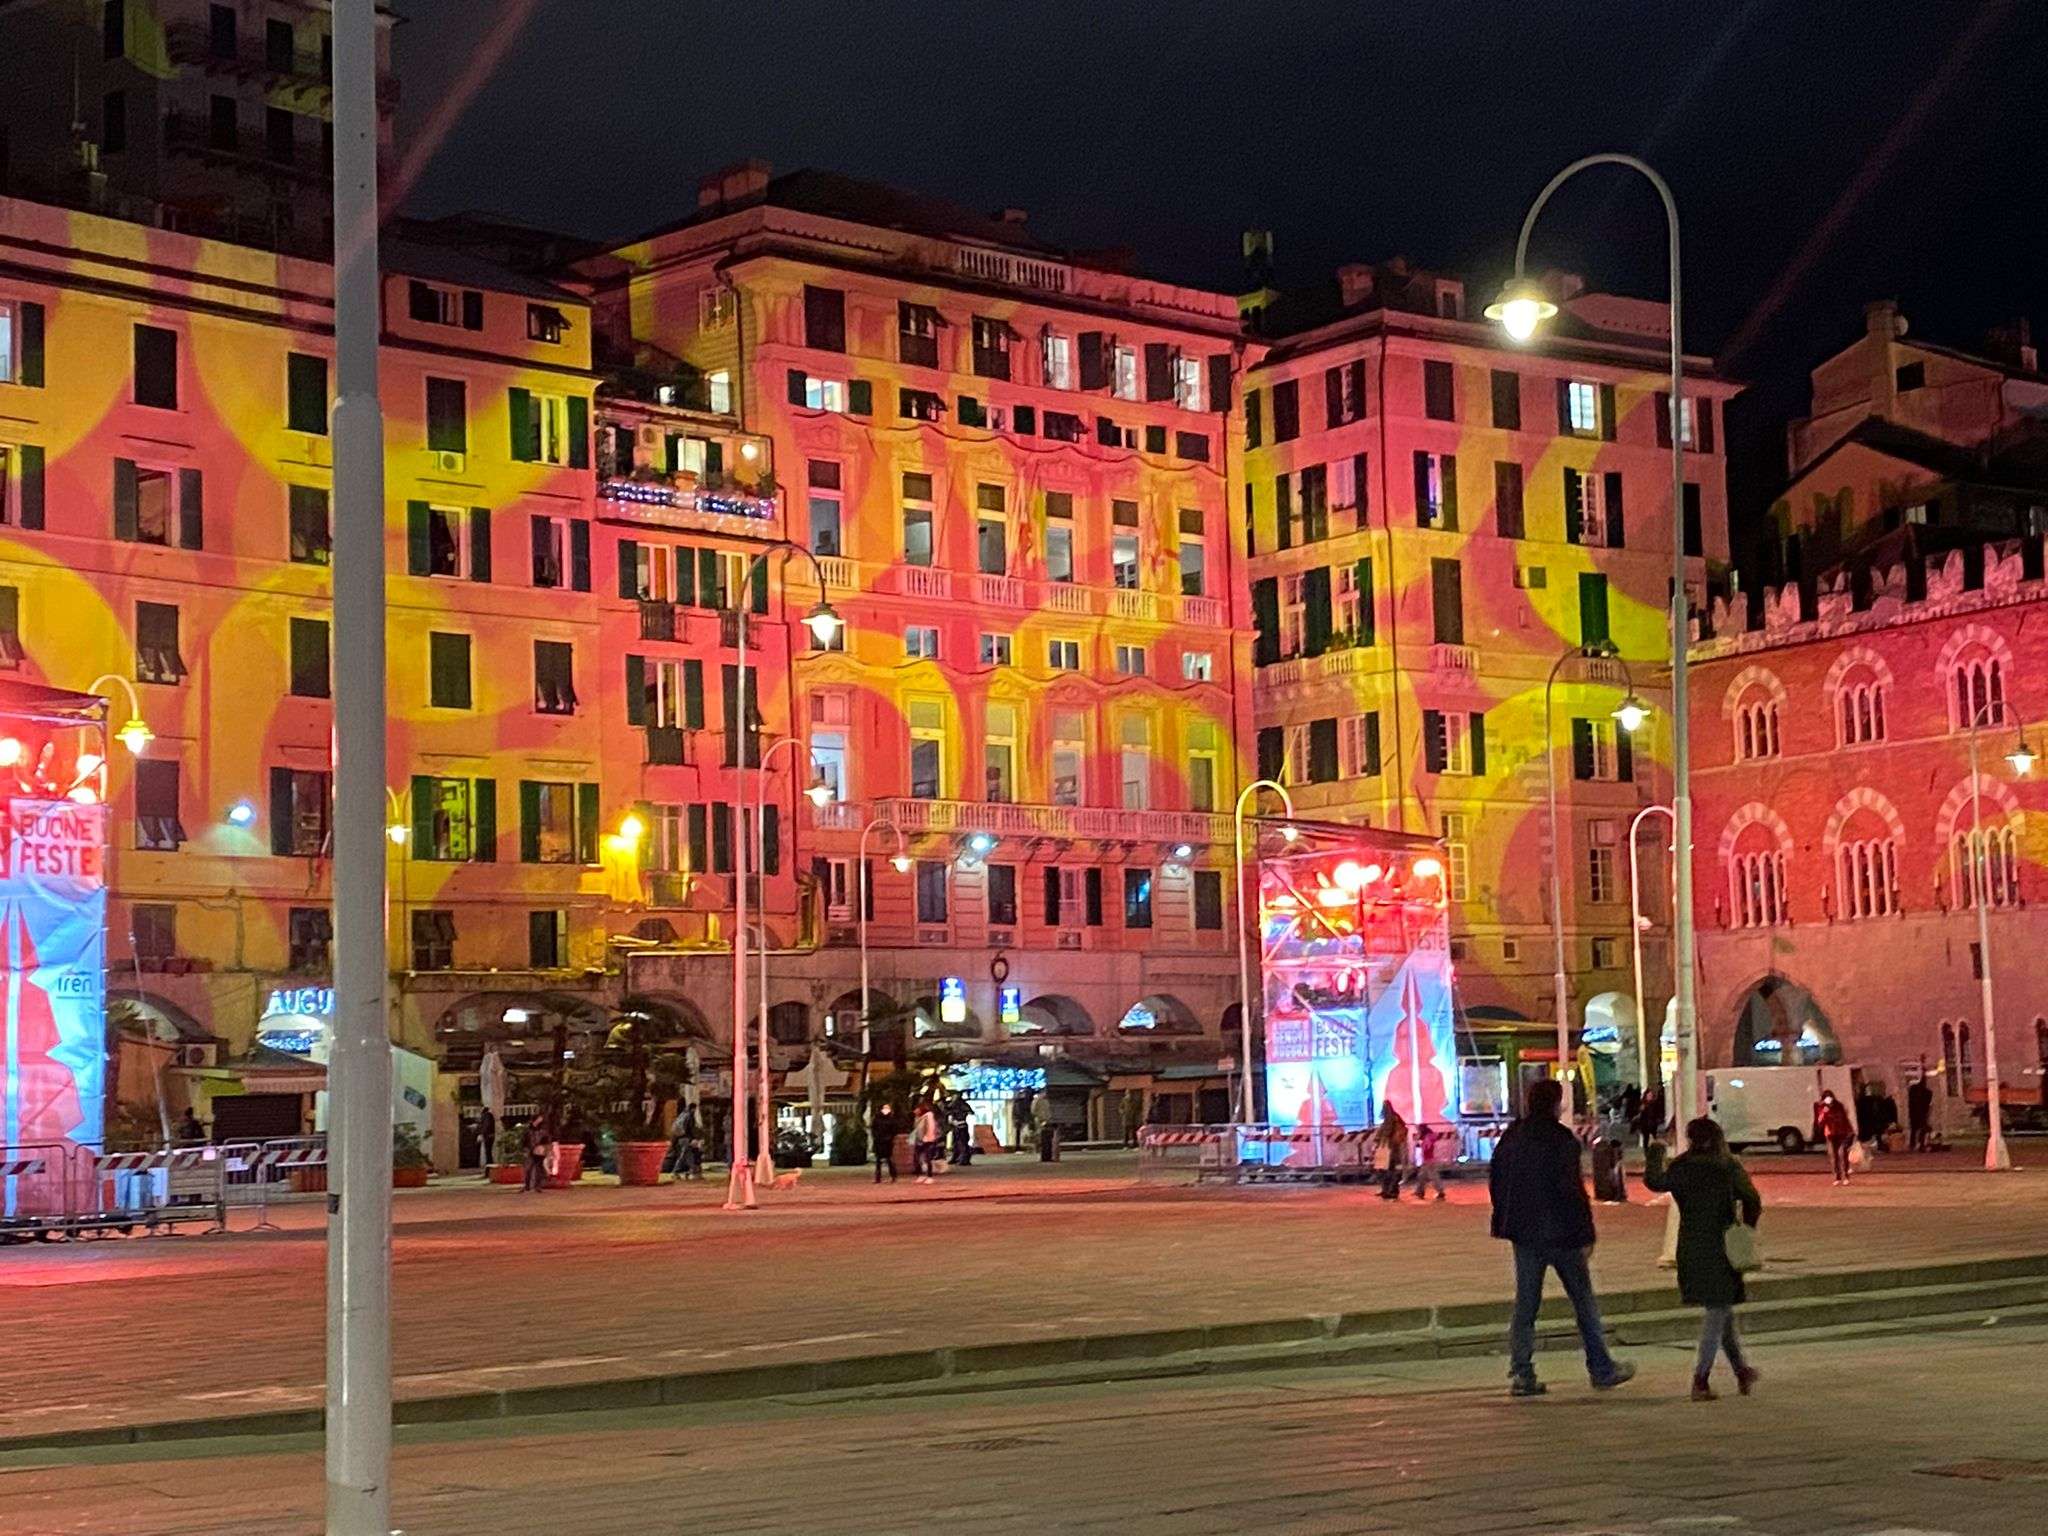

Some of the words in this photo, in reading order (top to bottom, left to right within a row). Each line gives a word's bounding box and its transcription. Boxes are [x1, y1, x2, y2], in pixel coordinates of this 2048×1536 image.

[19, 813, 94, 842] BUONE
[19, 842, 96, 877] FESTE
[1316, 1036, 1358, 1057] FESTE
